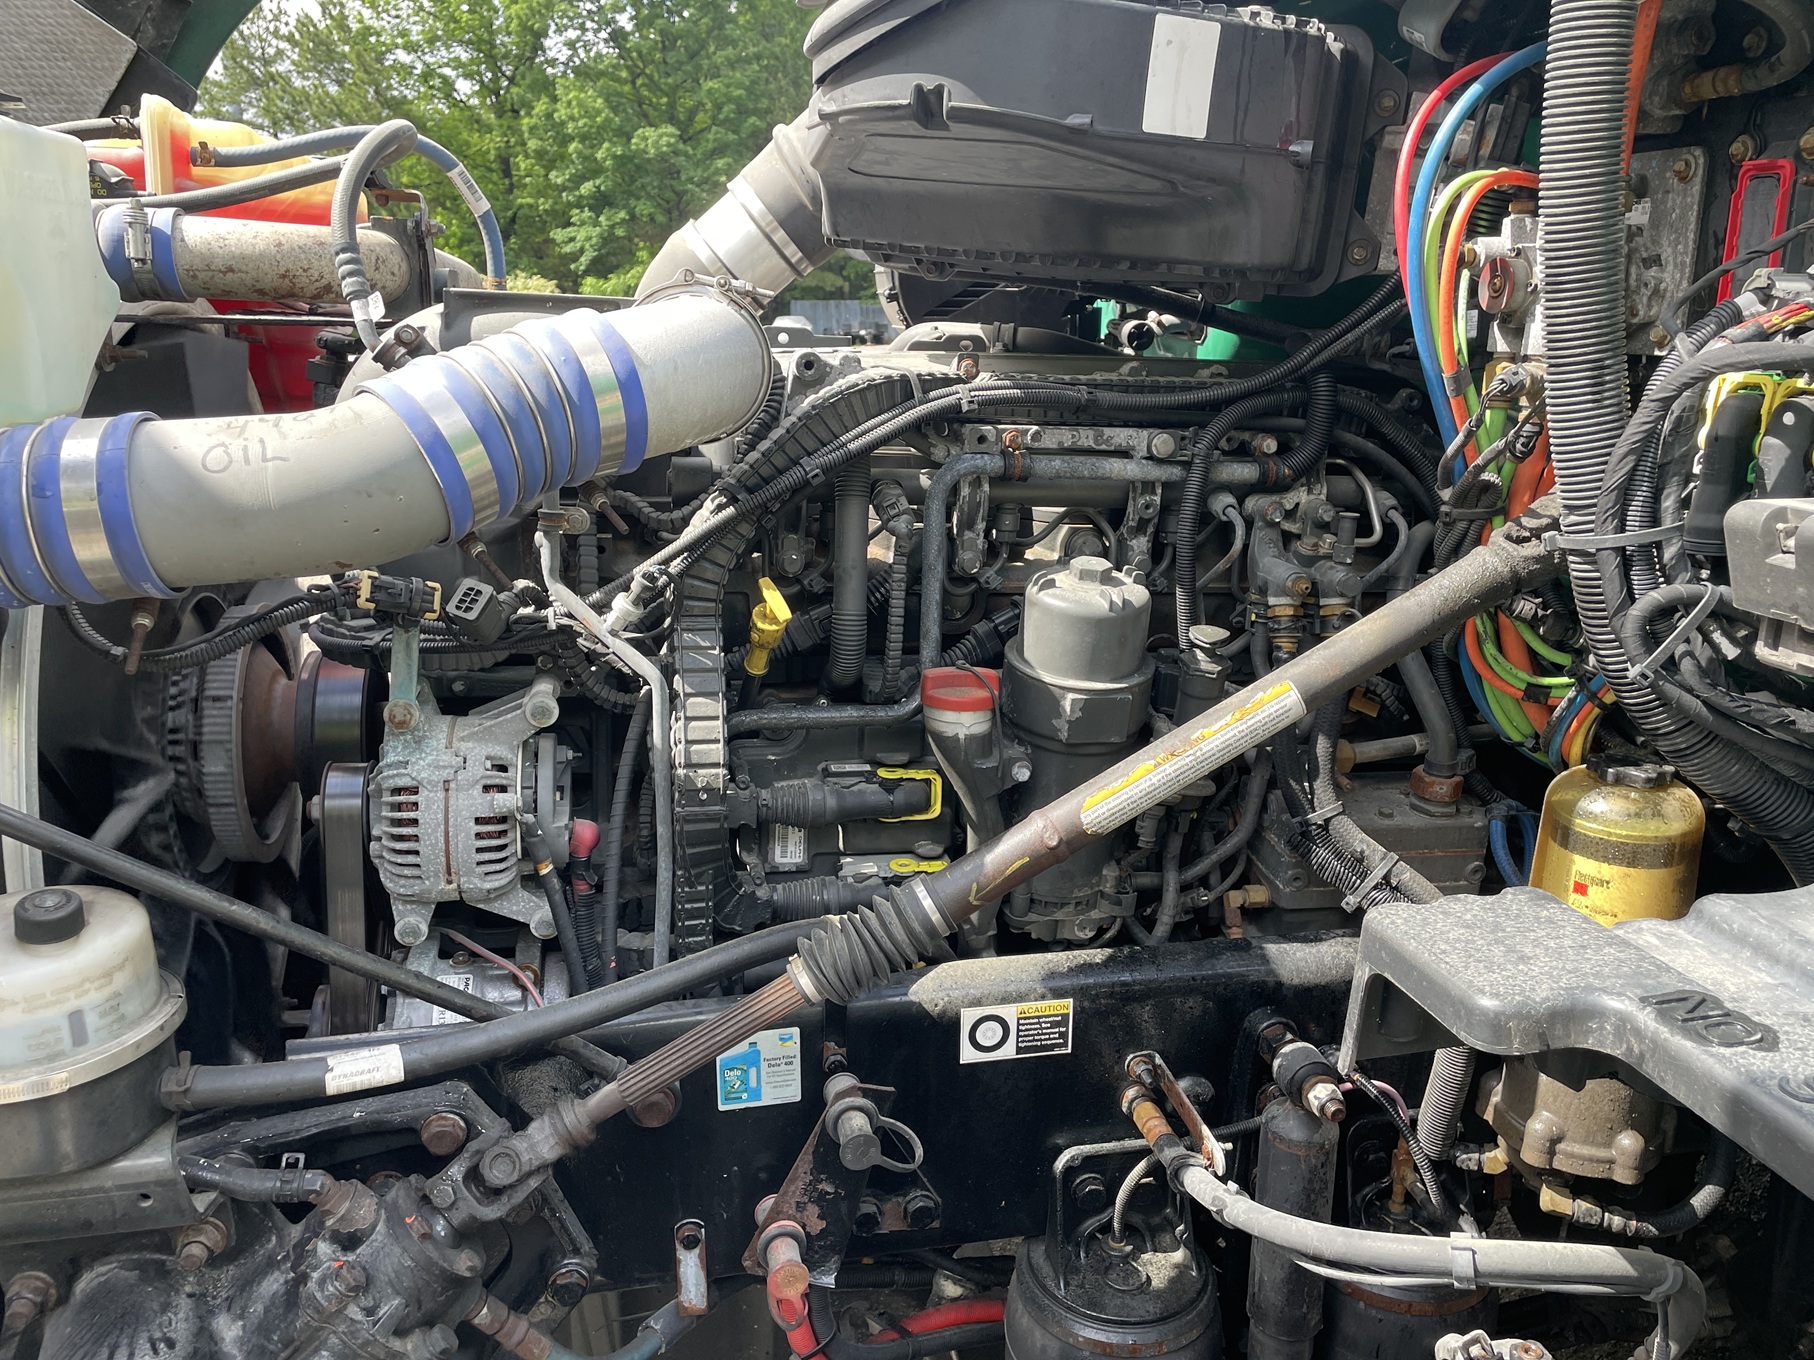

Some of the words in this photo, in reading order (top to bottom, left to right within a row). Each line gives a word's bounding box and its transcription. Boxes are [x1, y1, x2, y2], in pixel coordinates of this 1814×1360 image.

[1027, 1004, 1069, 1014] CAUTION
[1652, 996, 1764, 1048] NO
[331, 1066, 382, 1082] DYNACRAFT
[724, 1068, 741, 1077] Delo
